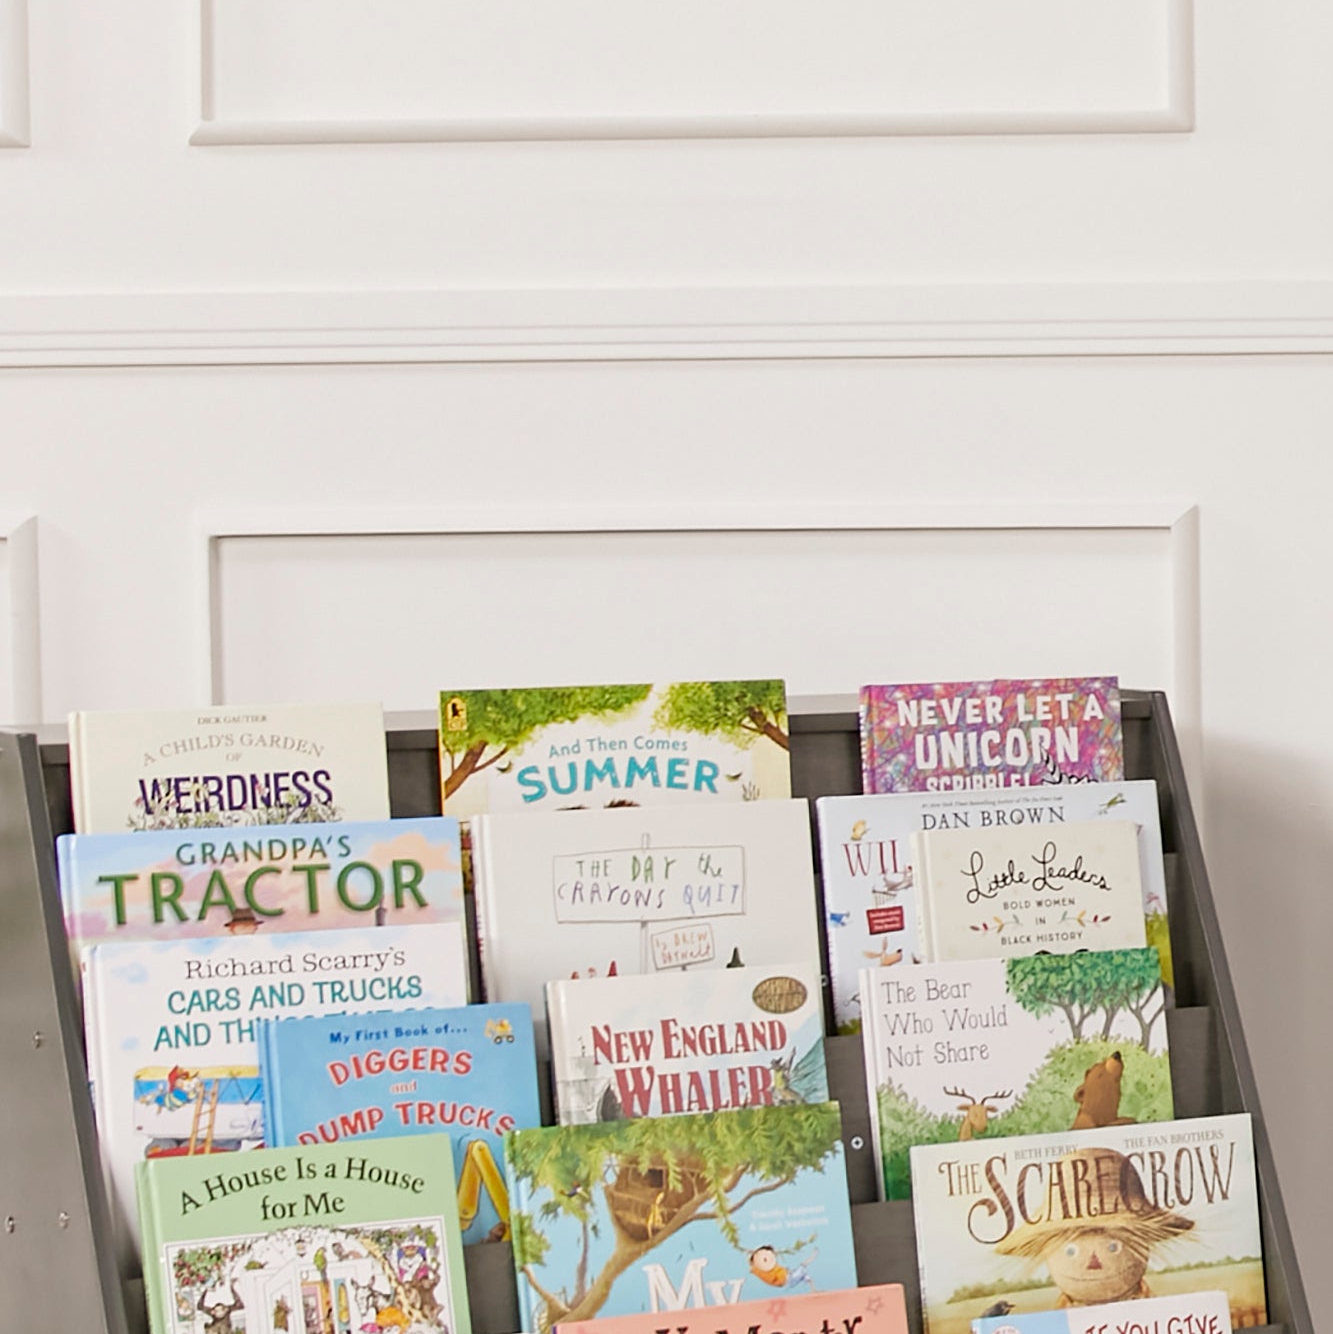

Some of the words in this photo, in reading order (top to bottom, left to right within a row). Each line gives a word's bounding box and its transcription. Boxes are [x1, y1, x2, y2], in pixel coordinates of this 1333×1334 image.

[898, 694, 1003, 728] NEVER
[1017, 693, 1075, 722] LET
[1082, 693, 1104, 721] A
[144, 753, 156, 766] A
[159, 734, 235, 758] CHILD'S
[240, 733, 325, 758] GARDEN
[548, 739, 581, 758] And
[586, 737, 629, 753] Then
[633, 735, 689, 752] Comes
[914, 726, 1080, 769] UNICORN
[138, 769, 334, 816] WEIRDNESS
[517, 755, 720, 803] SUMMER
[922, 812, 971, 830] DAN
[981, 806, 1066, 828] BROWN
[176, 835, 352, 866] GRANDPA'S
[841, 839, 905, 877] WIL
[575, 859, 612, 878] THE
[631, 854, 677, 884] DAY
[698, 852, 723, 879] the
[961, 851, 1029, 904] Little
[1032, 841, 1111, 893] Leaders
[97, 858, 429, 926] TRACTOR
[557, 881, 665, 909] CRAYONS
[683, 883, 740, 915] QUIT
[1003, 900, 1032, 911] BOLD
[1035, 896, 1076, 909] WOMEN
[1035, 916, 1046, 925] IN
[1001, 934, 1032, 947] BLACK
[1036, 930, 1083, 944] HISTORY
[184, 954, 295, 980] Richard
[303, 946, 407, 973] Scarry's
[167, 986, 241, 1016] CARS
[248, 981, 305, 1011] AND
[312, 974, 423, 1005] TRUCKS
[881, 980, 917, 1005] The
[927, 978, 972, 1001] Bear
[153, 1021, 212, 1052] AND
[330, 1031, 350, 1044] My
[356, 1029, 389, 1042] First
[395, 1024, 429, 1038] Book
[884, 1011, 935, 1037] Who
[942, 1005, 1009, 1032] Would
[591, 1023, 655, 1066] NEW
[660, 1018, 787, 1060] ENGLAND
[887, 1044, 923, 1069] Not
[934, 1039, 990, 1065] Share
[328, 1047, 473, 1086] DIGGERS
[390, 1081, 418, 1093] and
[614, 1065, 775, 1118] WHALER
[395, 1101, 517, 1137] TRUCKS
[1013, 1146, 1042, 1159] BETH
[1044, 1143, 1079, 1157] FERRY
[1124, 1137, 1144, 1149] THE
[1145, 1135, 1169, 1147] FAN
[1170, 1129, 1225, 1145] BROTHERS
[180, 1190, 203, 1216] A
[202, 1162, 288, 1203] House
[296, 1157, 317, 1180] Is
[324, 1163, 337, 1179] a
[345, 1157, 426, 1195] House
[938, 1160, 983, 1197] THE
[967, 1141, 1237, 1245] SCARECROW
[261, 1194, 298, 1222] for
[303, 1191, 346, 1217] Me
